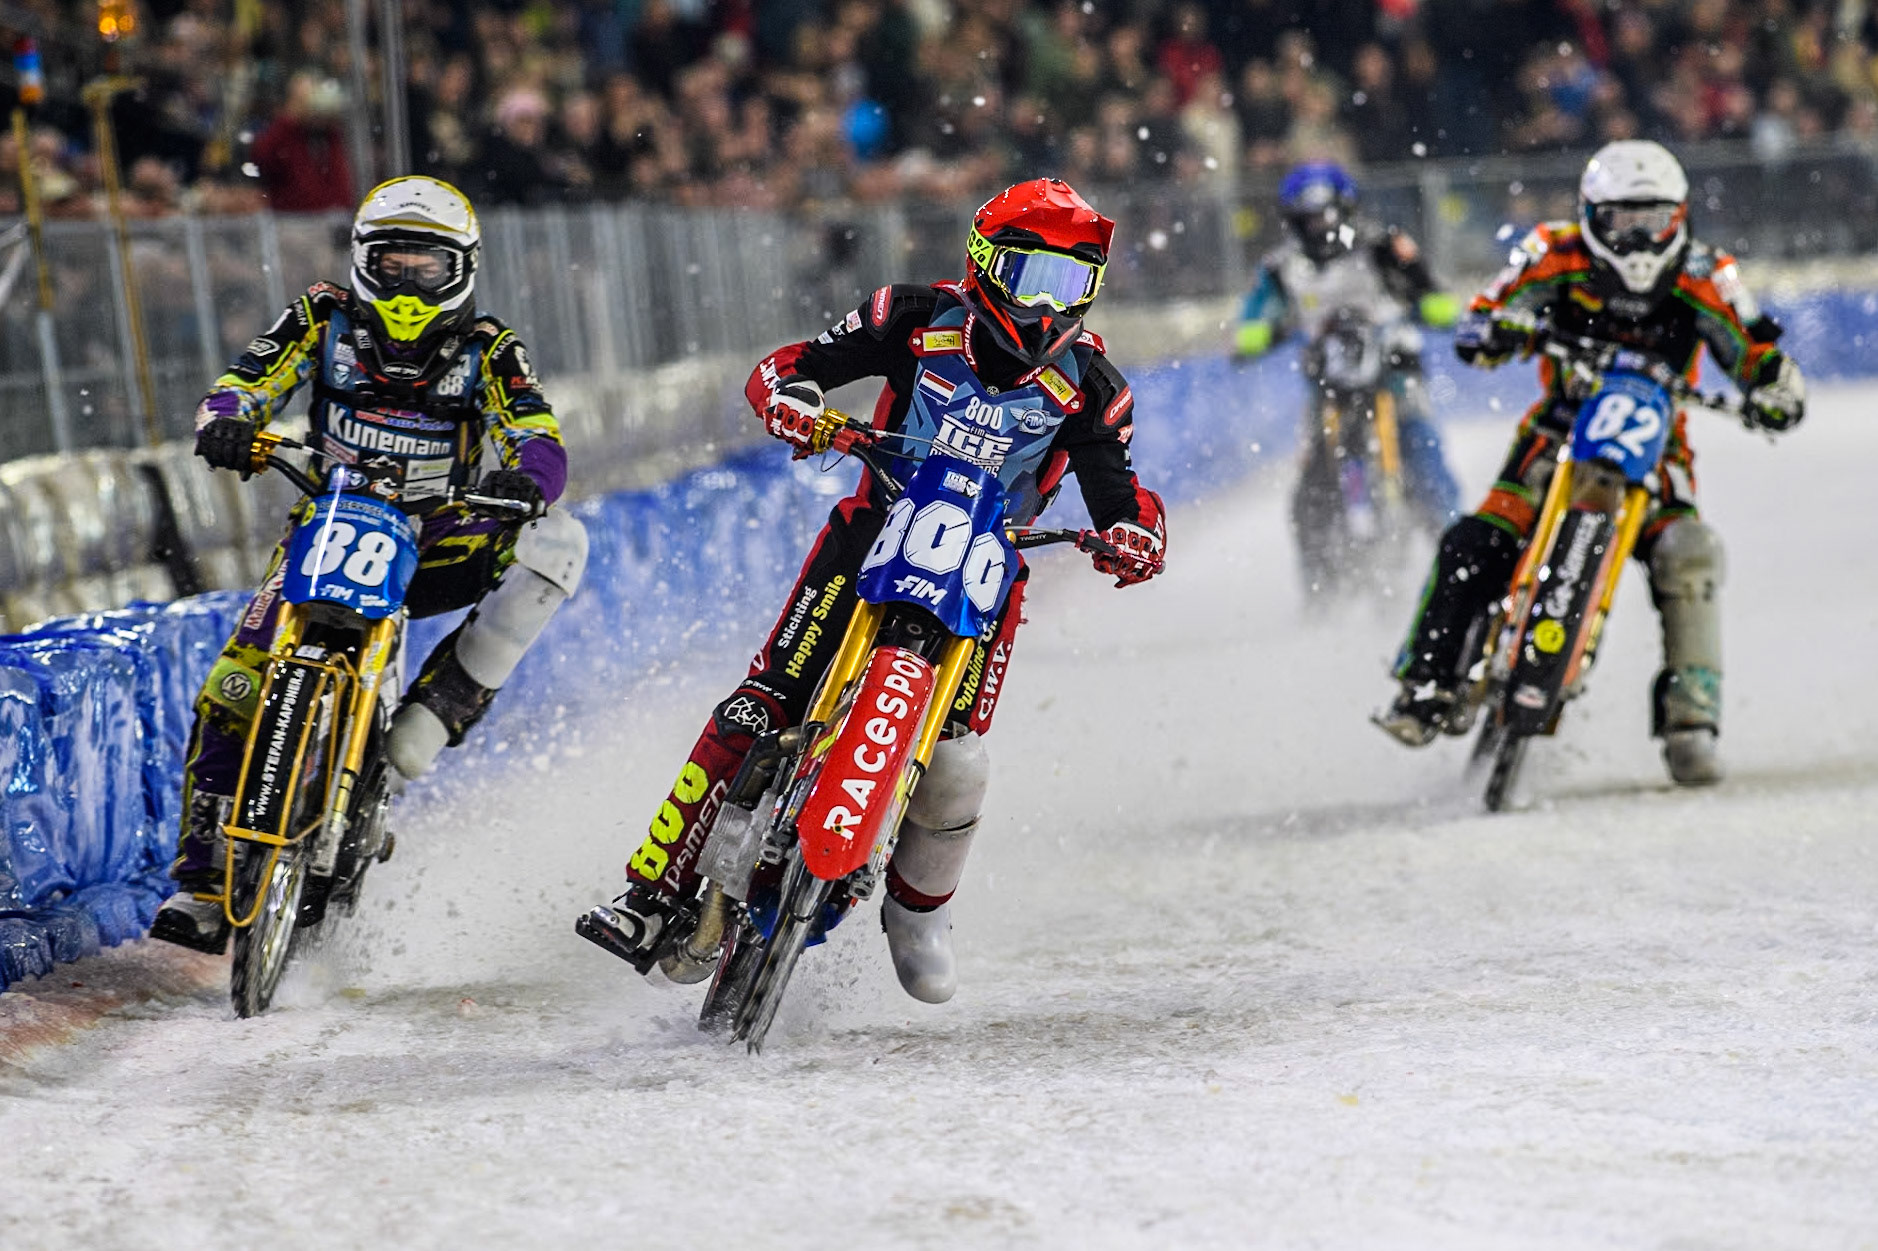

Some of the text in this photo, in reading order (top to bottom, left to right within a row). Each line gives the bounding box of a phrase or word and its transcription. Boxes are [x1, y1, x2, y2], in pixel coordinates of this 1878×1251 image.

[437, 375, 463, 396] 88
[965, 396, 1003, 430] 800
[328, 401, 451, 456] Kunemann
[933, 414, 1013, 461] ICE
[1025, 415, 1043, 427] FIM
[1585, 393, 1661, 457] 82
[301, 522, 397, 587] 88
[862, 497, 1005, 613] 800
[320, 584, 354, 601] FIM
[778, 586, 817, 649] Stichting
[894, 575, 948, 606] FIM
[785, 574, 847, 679] Happy Smile
[954, 645, 985, 711] Putoline
[978, 640, 1012, 721] C.W.V.
[630, 761, 709, 881] 800
